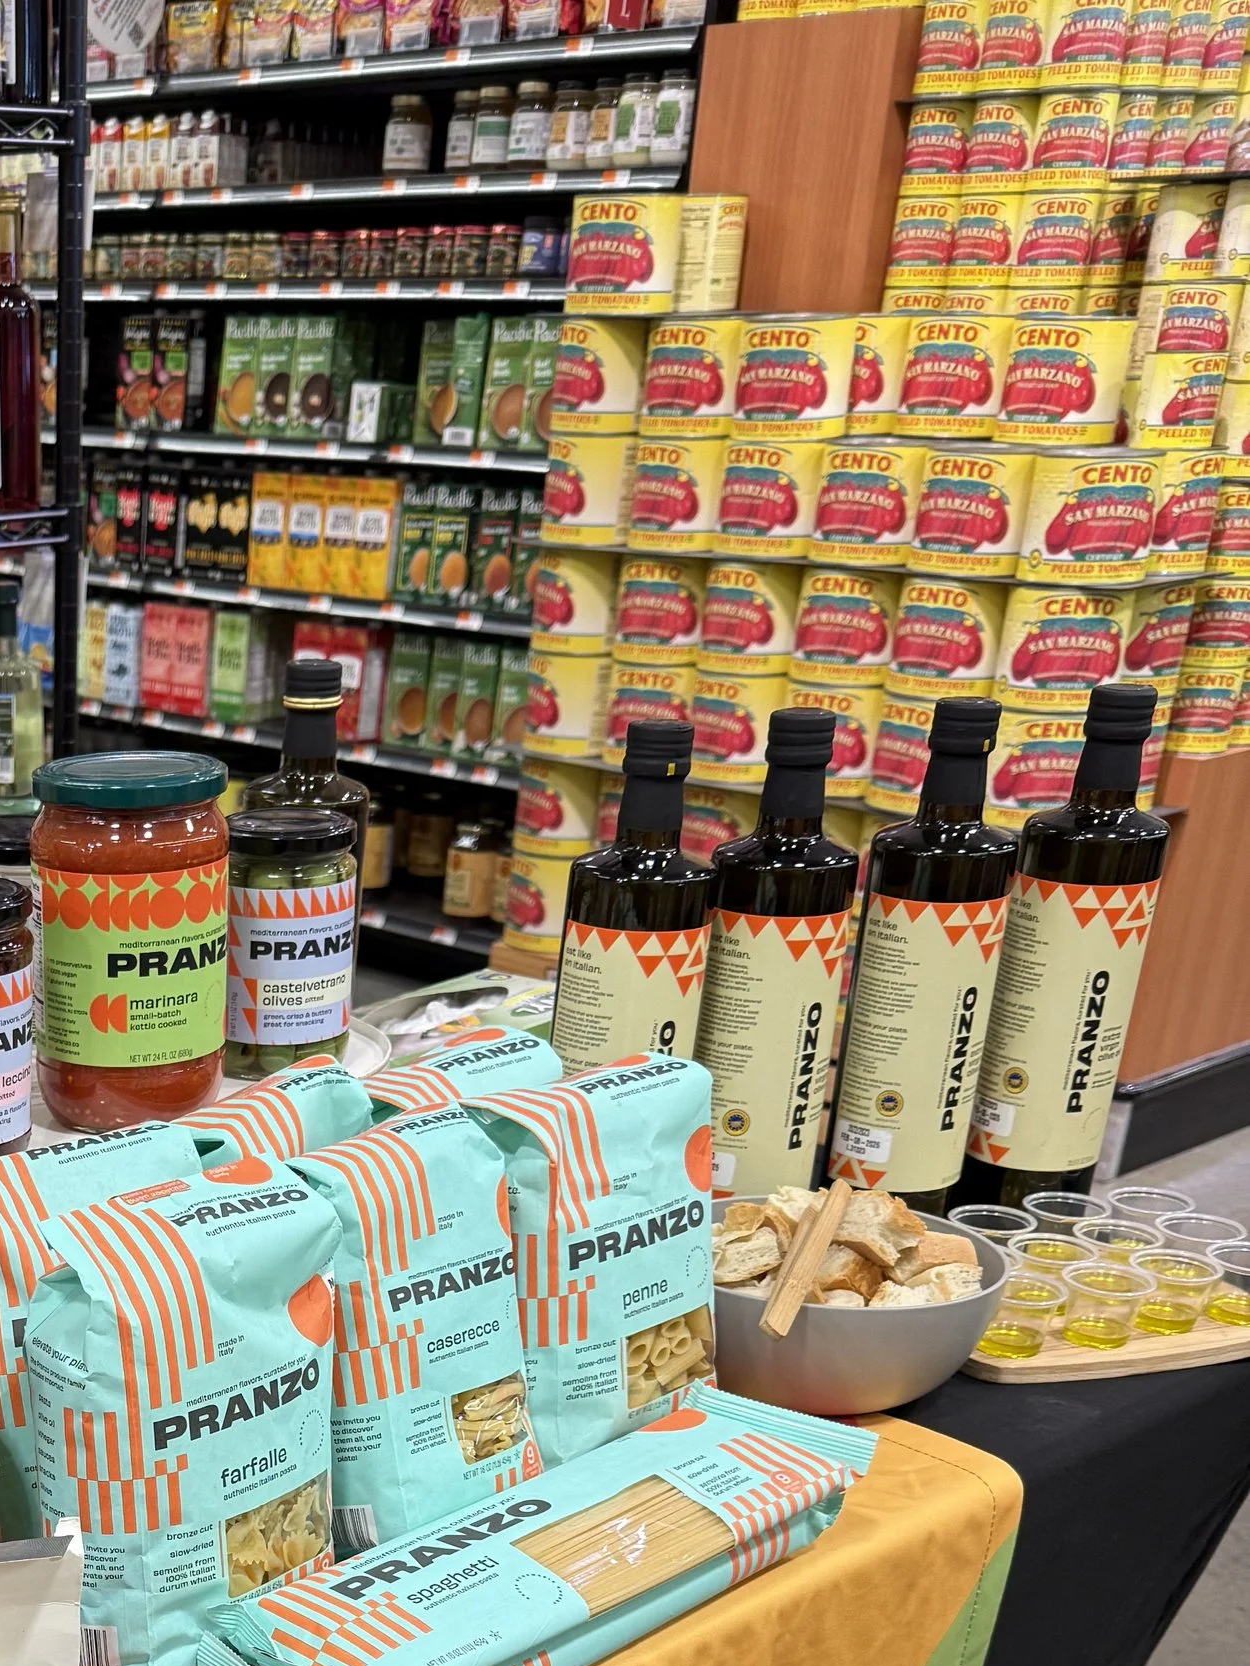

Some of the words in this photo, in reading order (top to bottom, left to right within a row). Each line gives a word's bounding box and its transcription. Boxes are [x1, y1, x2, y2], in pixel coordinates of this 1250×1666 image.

[988, 69, 1038, 82] TOMATOES
[1048, 62, 1082, 75] PEELED
[1052, 99, 1102, 115] CENTO
[580, 203, 638, 221] CENTO
[1037, 200, 1087, 214] CENTO
[1020, 296, 1070, 310] CENTO
[654, 328, 706, 345] CENTO
[749, 327, 810, 347] CENTO
[917, 324, 979, 343] CENTO
[1018, 329, 1080, 348] CENTO
[1023, 426, 1079, 435] TOMATOES
[728, 448, 782, 466] CENTO
[1082, 466, 1150, 484] CENTO
[1065, 506, 1092, 524] SAN
[1052, 563, 1095, 574] PEELED
[882, 919, 897, 930] like
[877, 930, 908, 944] italian.
[577, 949, 591, 960] like
[263, 974, 345, 994] castelvetrano
[130, 992, 198, 1010] marinara
[263, 994, 303, 1006] olives
[130, 1009, 181, 1020] small-batch
[130, 1022, 155, 1031] kettle
[157, 1018, 187, 1029] cooked
[1066, 970, 1110, 1114] PRANZO
[130, 1054, 140, 1062] NET
[141, 1053, 151, 1062] WT
[152, 1052, 161, 1061] 24
[170, 1051, 177, 1059] OZ
[436, 1038, 540, 1073] PRANZO
[940, 985, 977, 1132] PRANZO
[578, 1060, 689, 1095] PRANZO
[788, 1001, 822, 1150] PRANZO
[568, 1200, 704, 1270] PRANZO
[388, 1251, 515, 1313] PRANZO
[623, 1277, 668, 1310] penne
[218, 1336, 235, 1349] made
[236, 1334, 245, 1343] in
[427, 1319, 500, 1353] caserecce
[218, 1347, 235, 1358] italy
[154, 1358, 319, 1451] PRANZO
[220, 1448, 288, 1487] farfalle
[223, 1479, 259, 1501] authentic
[260, 1472, 278, 1485] italian
[278, 1464, 297, 1480] pasta
[166, 1529, 198, 1541] bronze
[200, 1524, 213, 1534] cut
[170, 1540, 214, 1558] slow-dried
[330, 1498, 551, 1600] PRANZO
[153, 1563, 193, 1578] semolina
[194, 1556, 215, 1568] from
[165, 1572, 188, 1583] 100%
[189, 1565, 216, 1580] italian
[159, 1580, 188, 1594] durum
[190, 1573, 216, 1586] wheat
[408, 1555, 497, 1605] spaghetti
